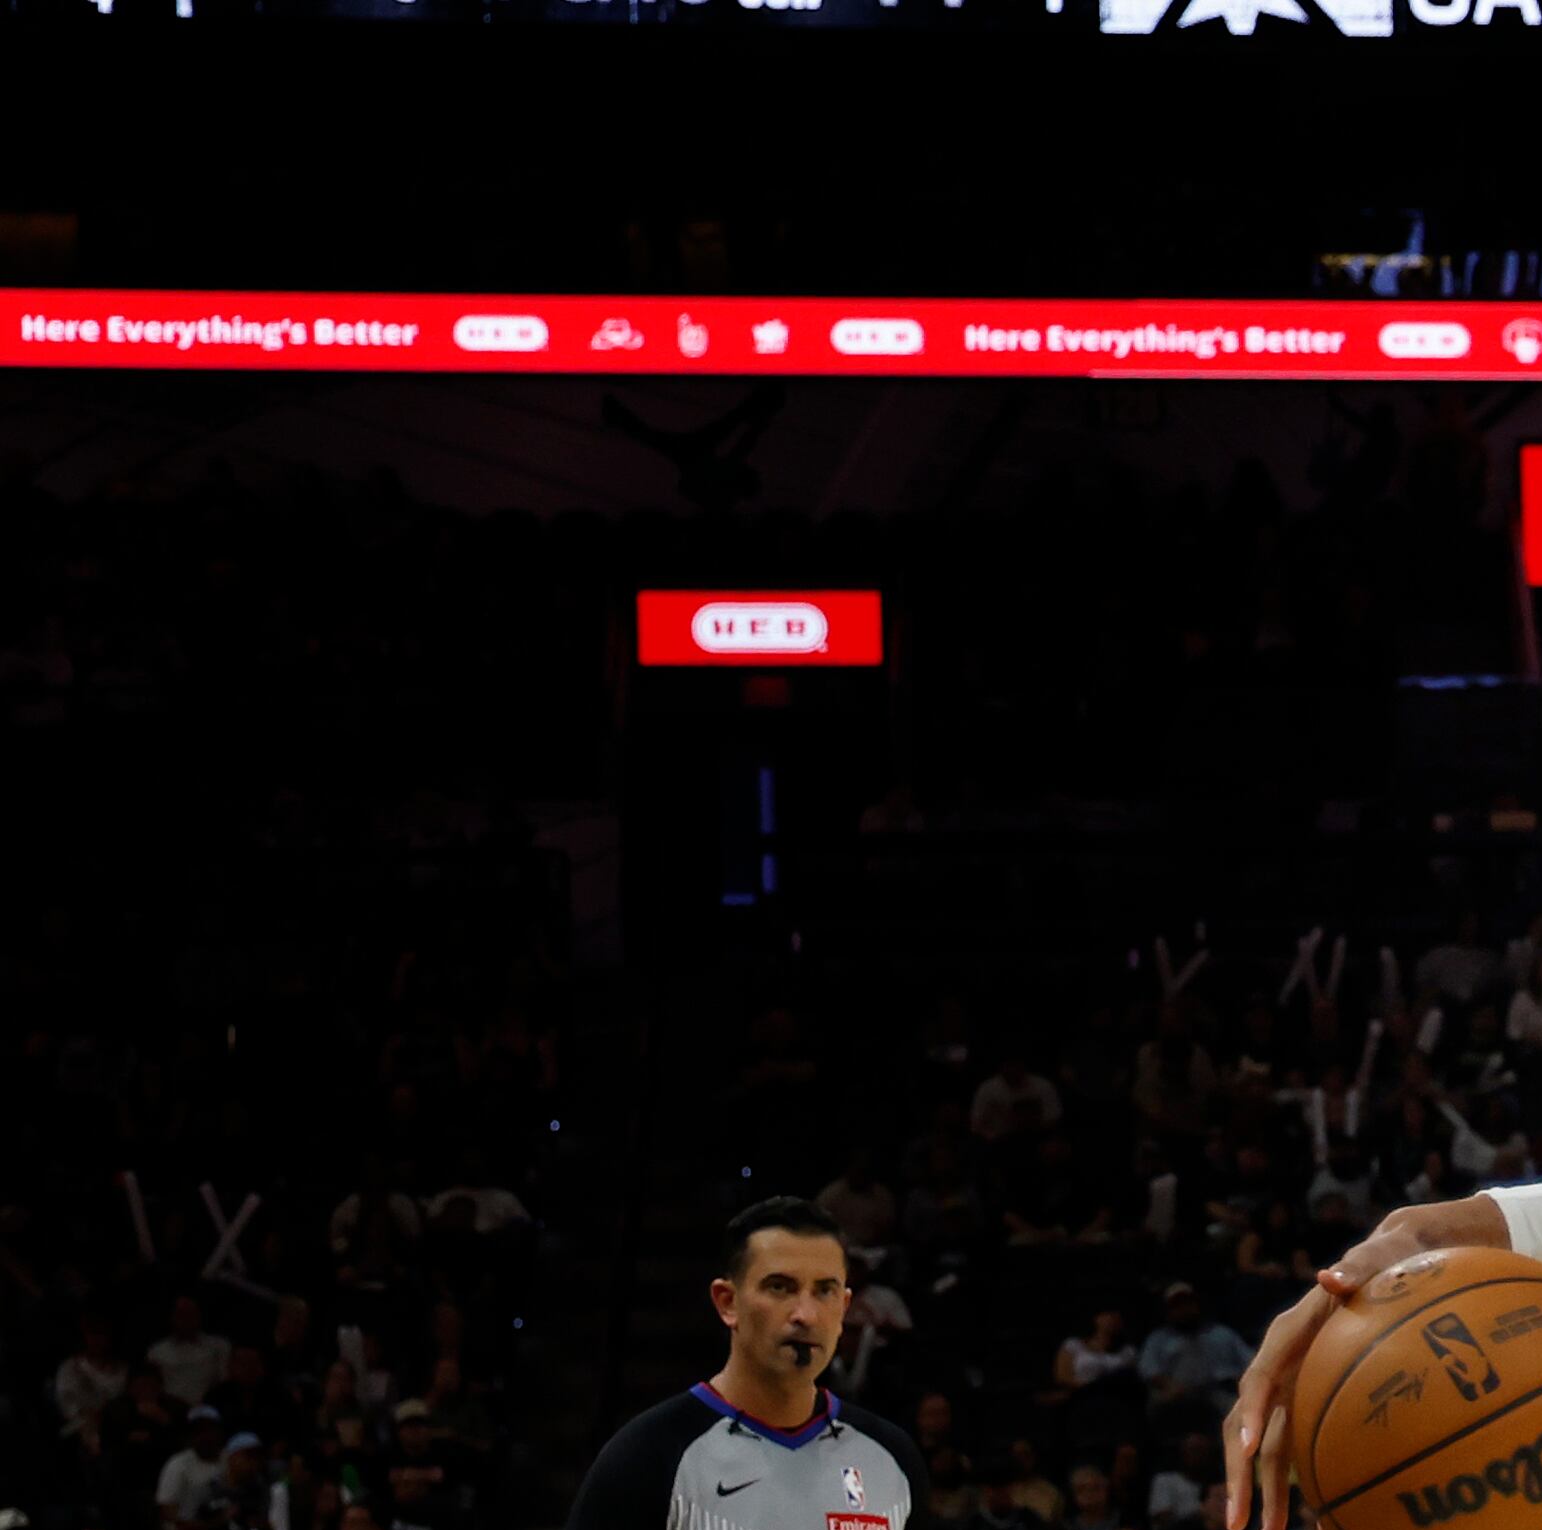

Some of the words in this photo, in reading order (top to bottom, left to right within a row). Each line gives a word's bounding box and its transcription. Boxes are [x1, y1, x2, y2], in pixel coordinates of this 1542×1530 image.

[22, 316, 100, 342] Here
[107, 316, 306, 350] Everything's
[314, 319, 417, 345] Better
[965, 324, 1040, 351] Here
[1047, 324, 1239, 358] Everything's
[1245, 327, 1344, 353] Better
